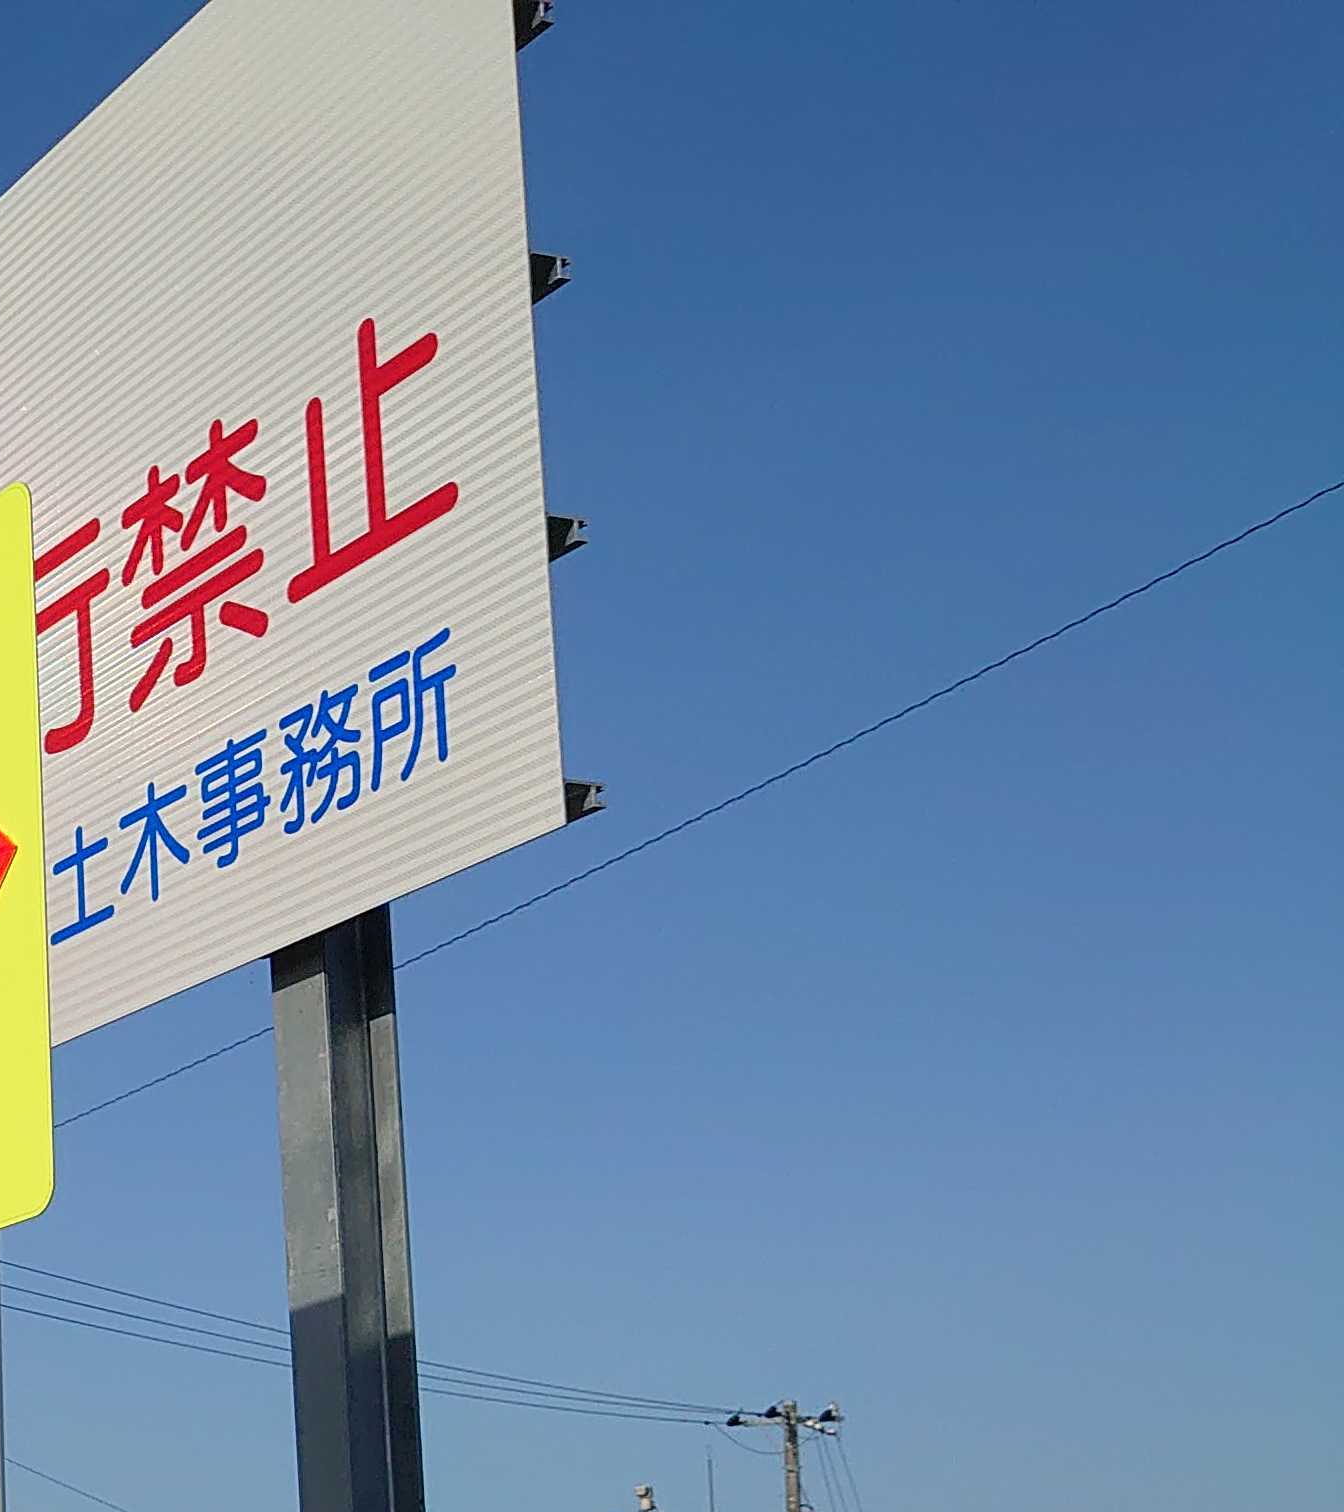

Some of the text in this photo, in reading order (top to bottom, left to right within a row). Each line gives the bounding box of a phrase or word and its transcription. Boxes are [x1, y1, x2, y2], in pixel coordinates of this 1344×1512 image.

[51, 627, 457, 946] 土木事務所
